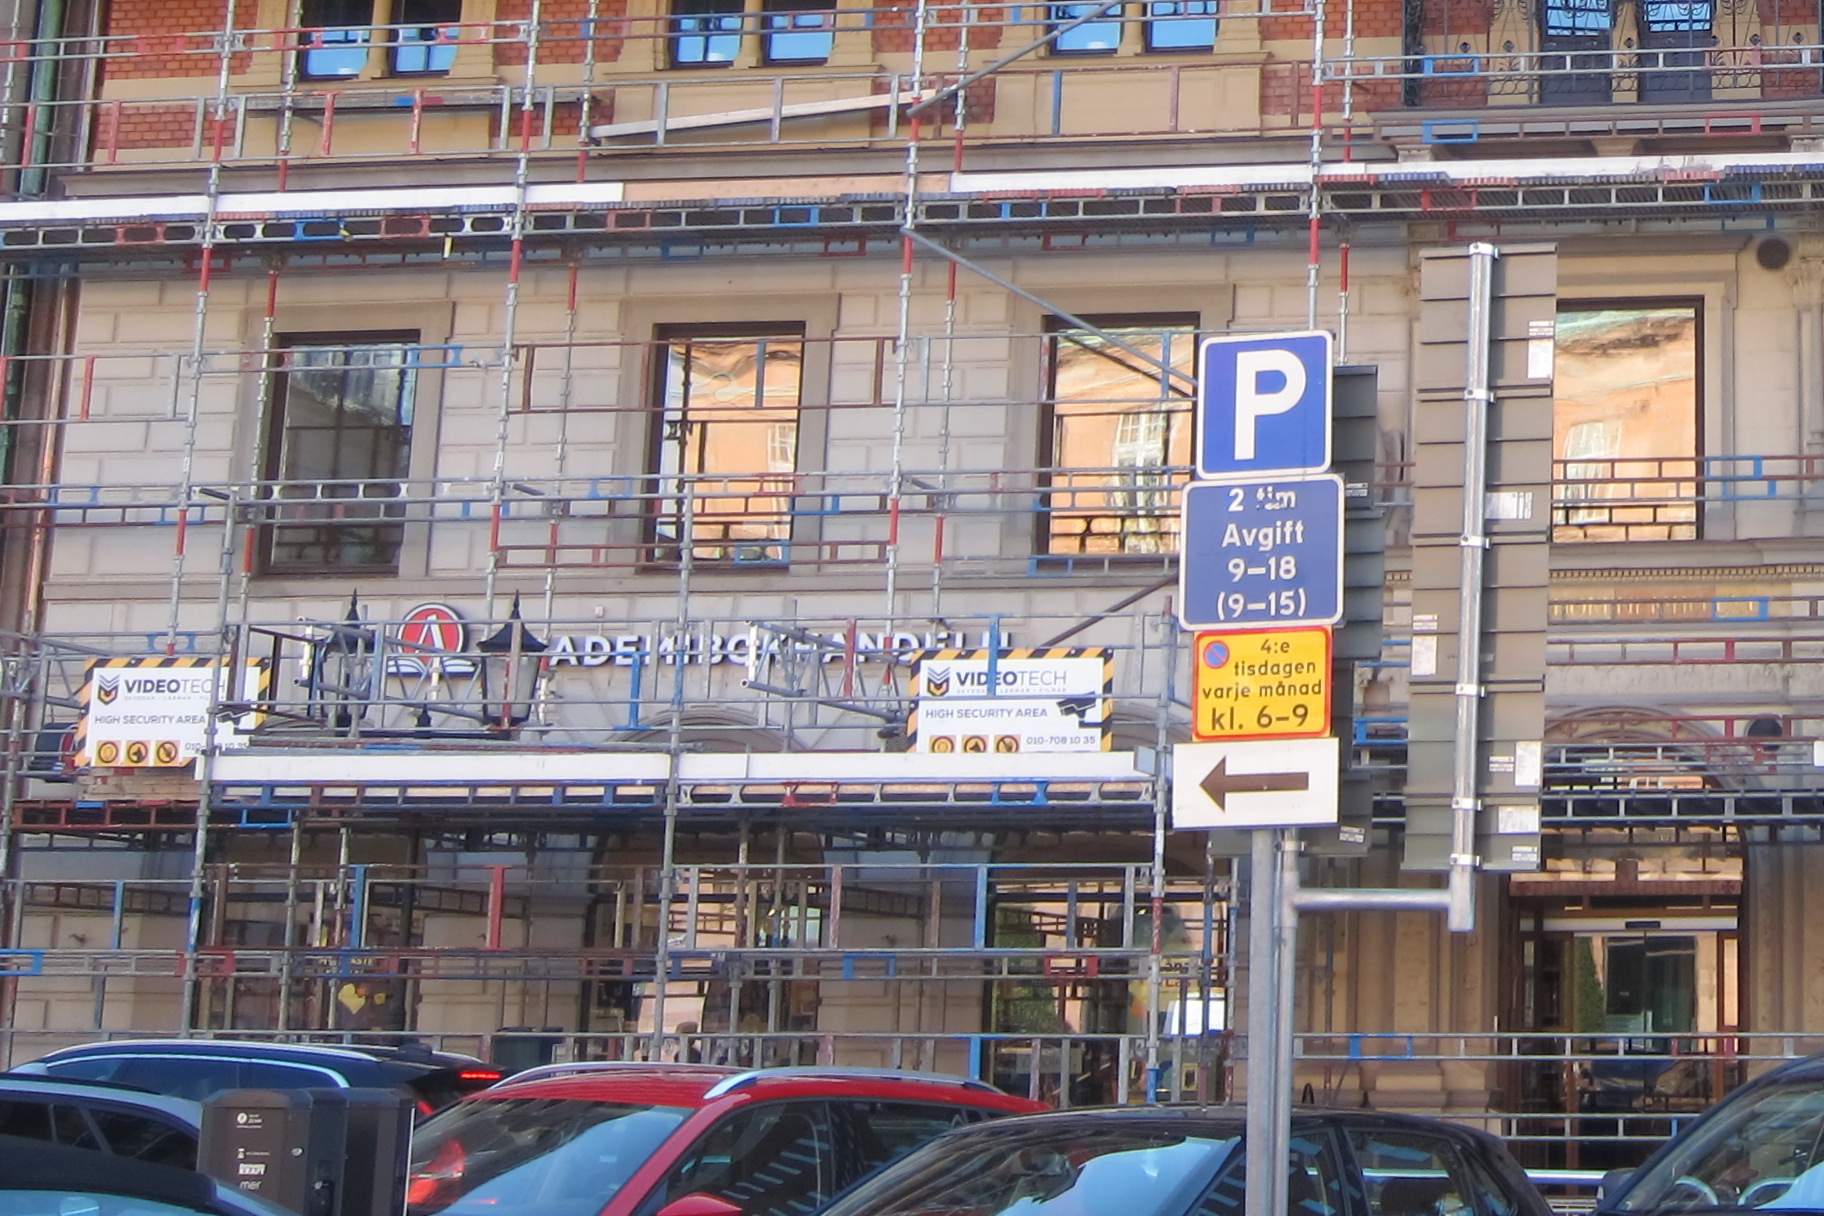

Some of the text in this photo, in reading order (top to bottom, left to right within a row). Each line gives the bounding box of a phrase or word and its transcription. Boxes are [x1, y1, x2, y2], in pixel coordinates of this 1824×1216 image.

[1233, 349, 1306, 460] P
[1228, 486, 1296, 512] 2 tim
[1221, 521, 1304, 552] Avgift
[1261, 639, 1290, 654] 4:e
[1234, 660, 1316, 678] tisdagen
[1202, 680, 1321, 702] varje månad
[95, 714, 206, 724] HIGH SECURITY AREA
[926, 708, 1048, 719] HIGH SECURITY AREA
[1212, 706, 1243, 731] kl.
[1026, 735, 1096, 745] 010-708 10 35
